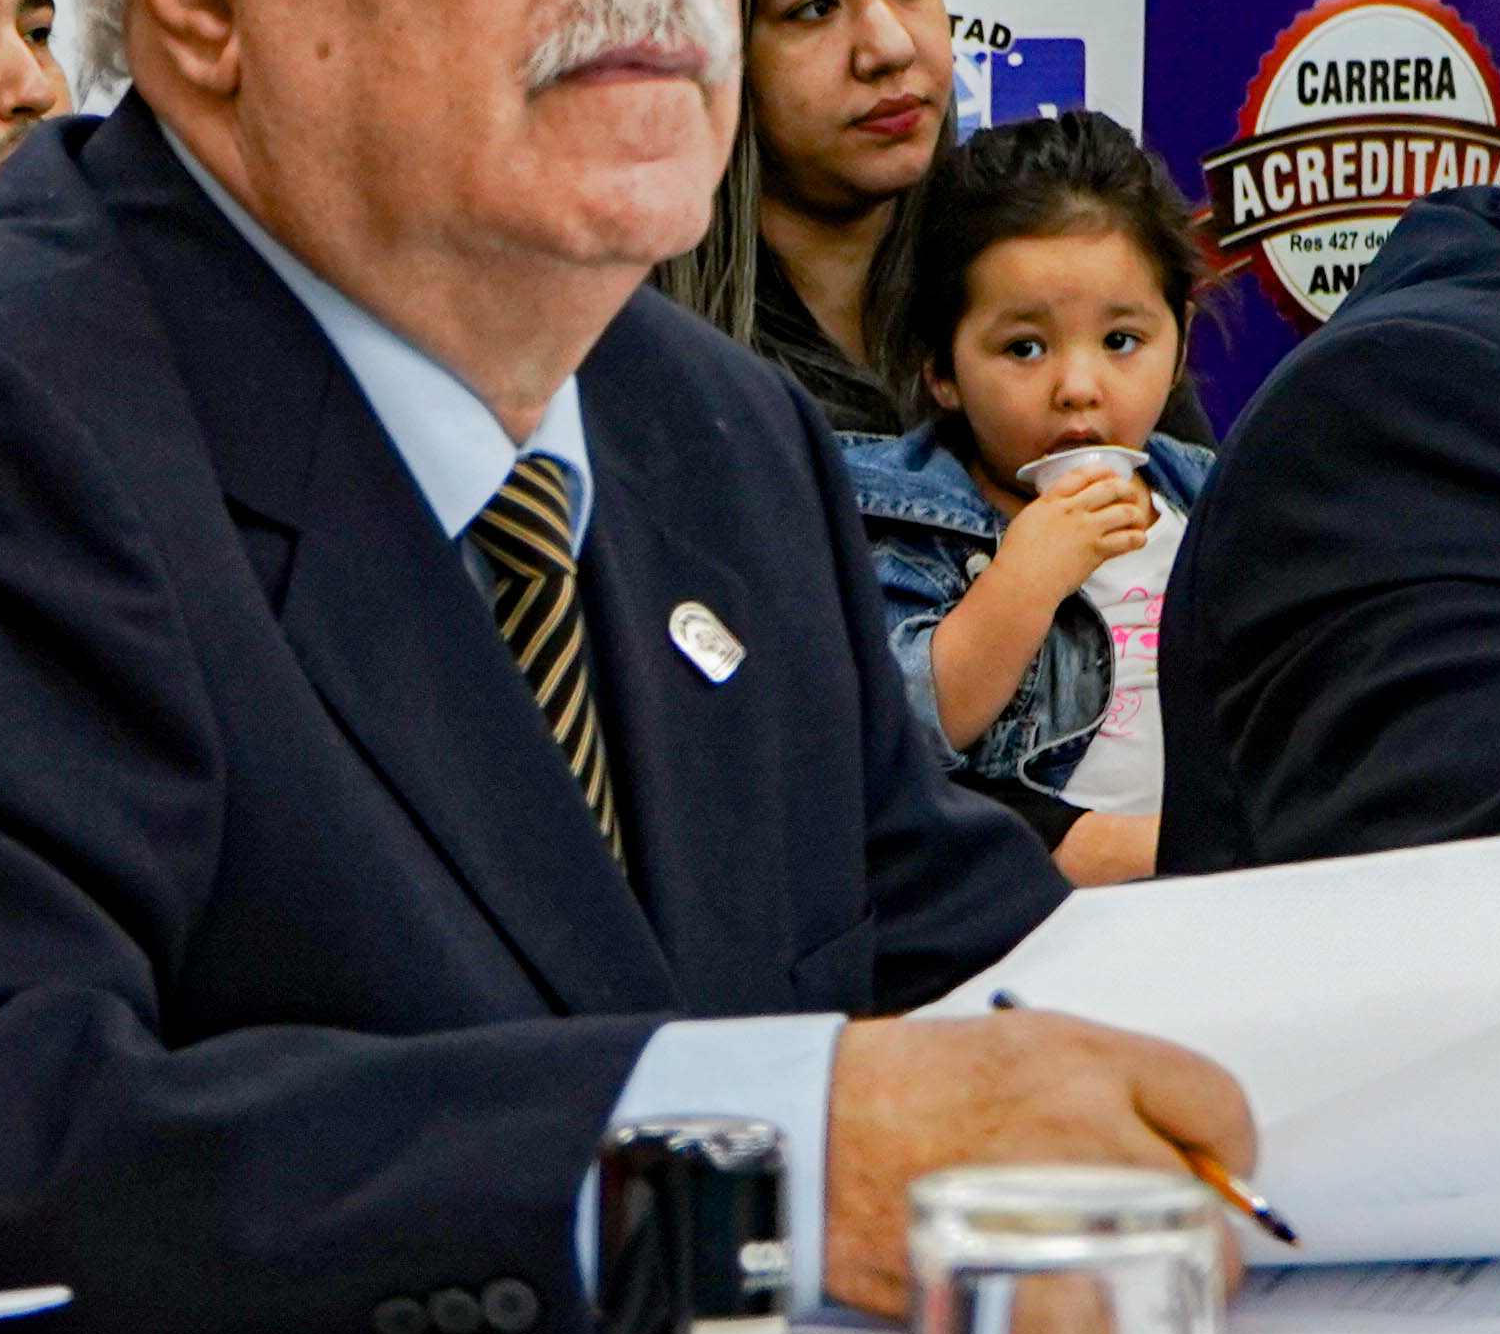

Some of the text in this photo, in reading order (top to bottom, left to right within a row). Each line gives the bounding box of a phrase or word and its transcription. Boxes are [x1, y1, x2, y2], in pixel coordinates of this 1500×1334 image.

[1297, 57, 1456, 106] CARRERA
[1290, 233, 1323, 252] Res
[1329, 231, 1357, 250] 427
